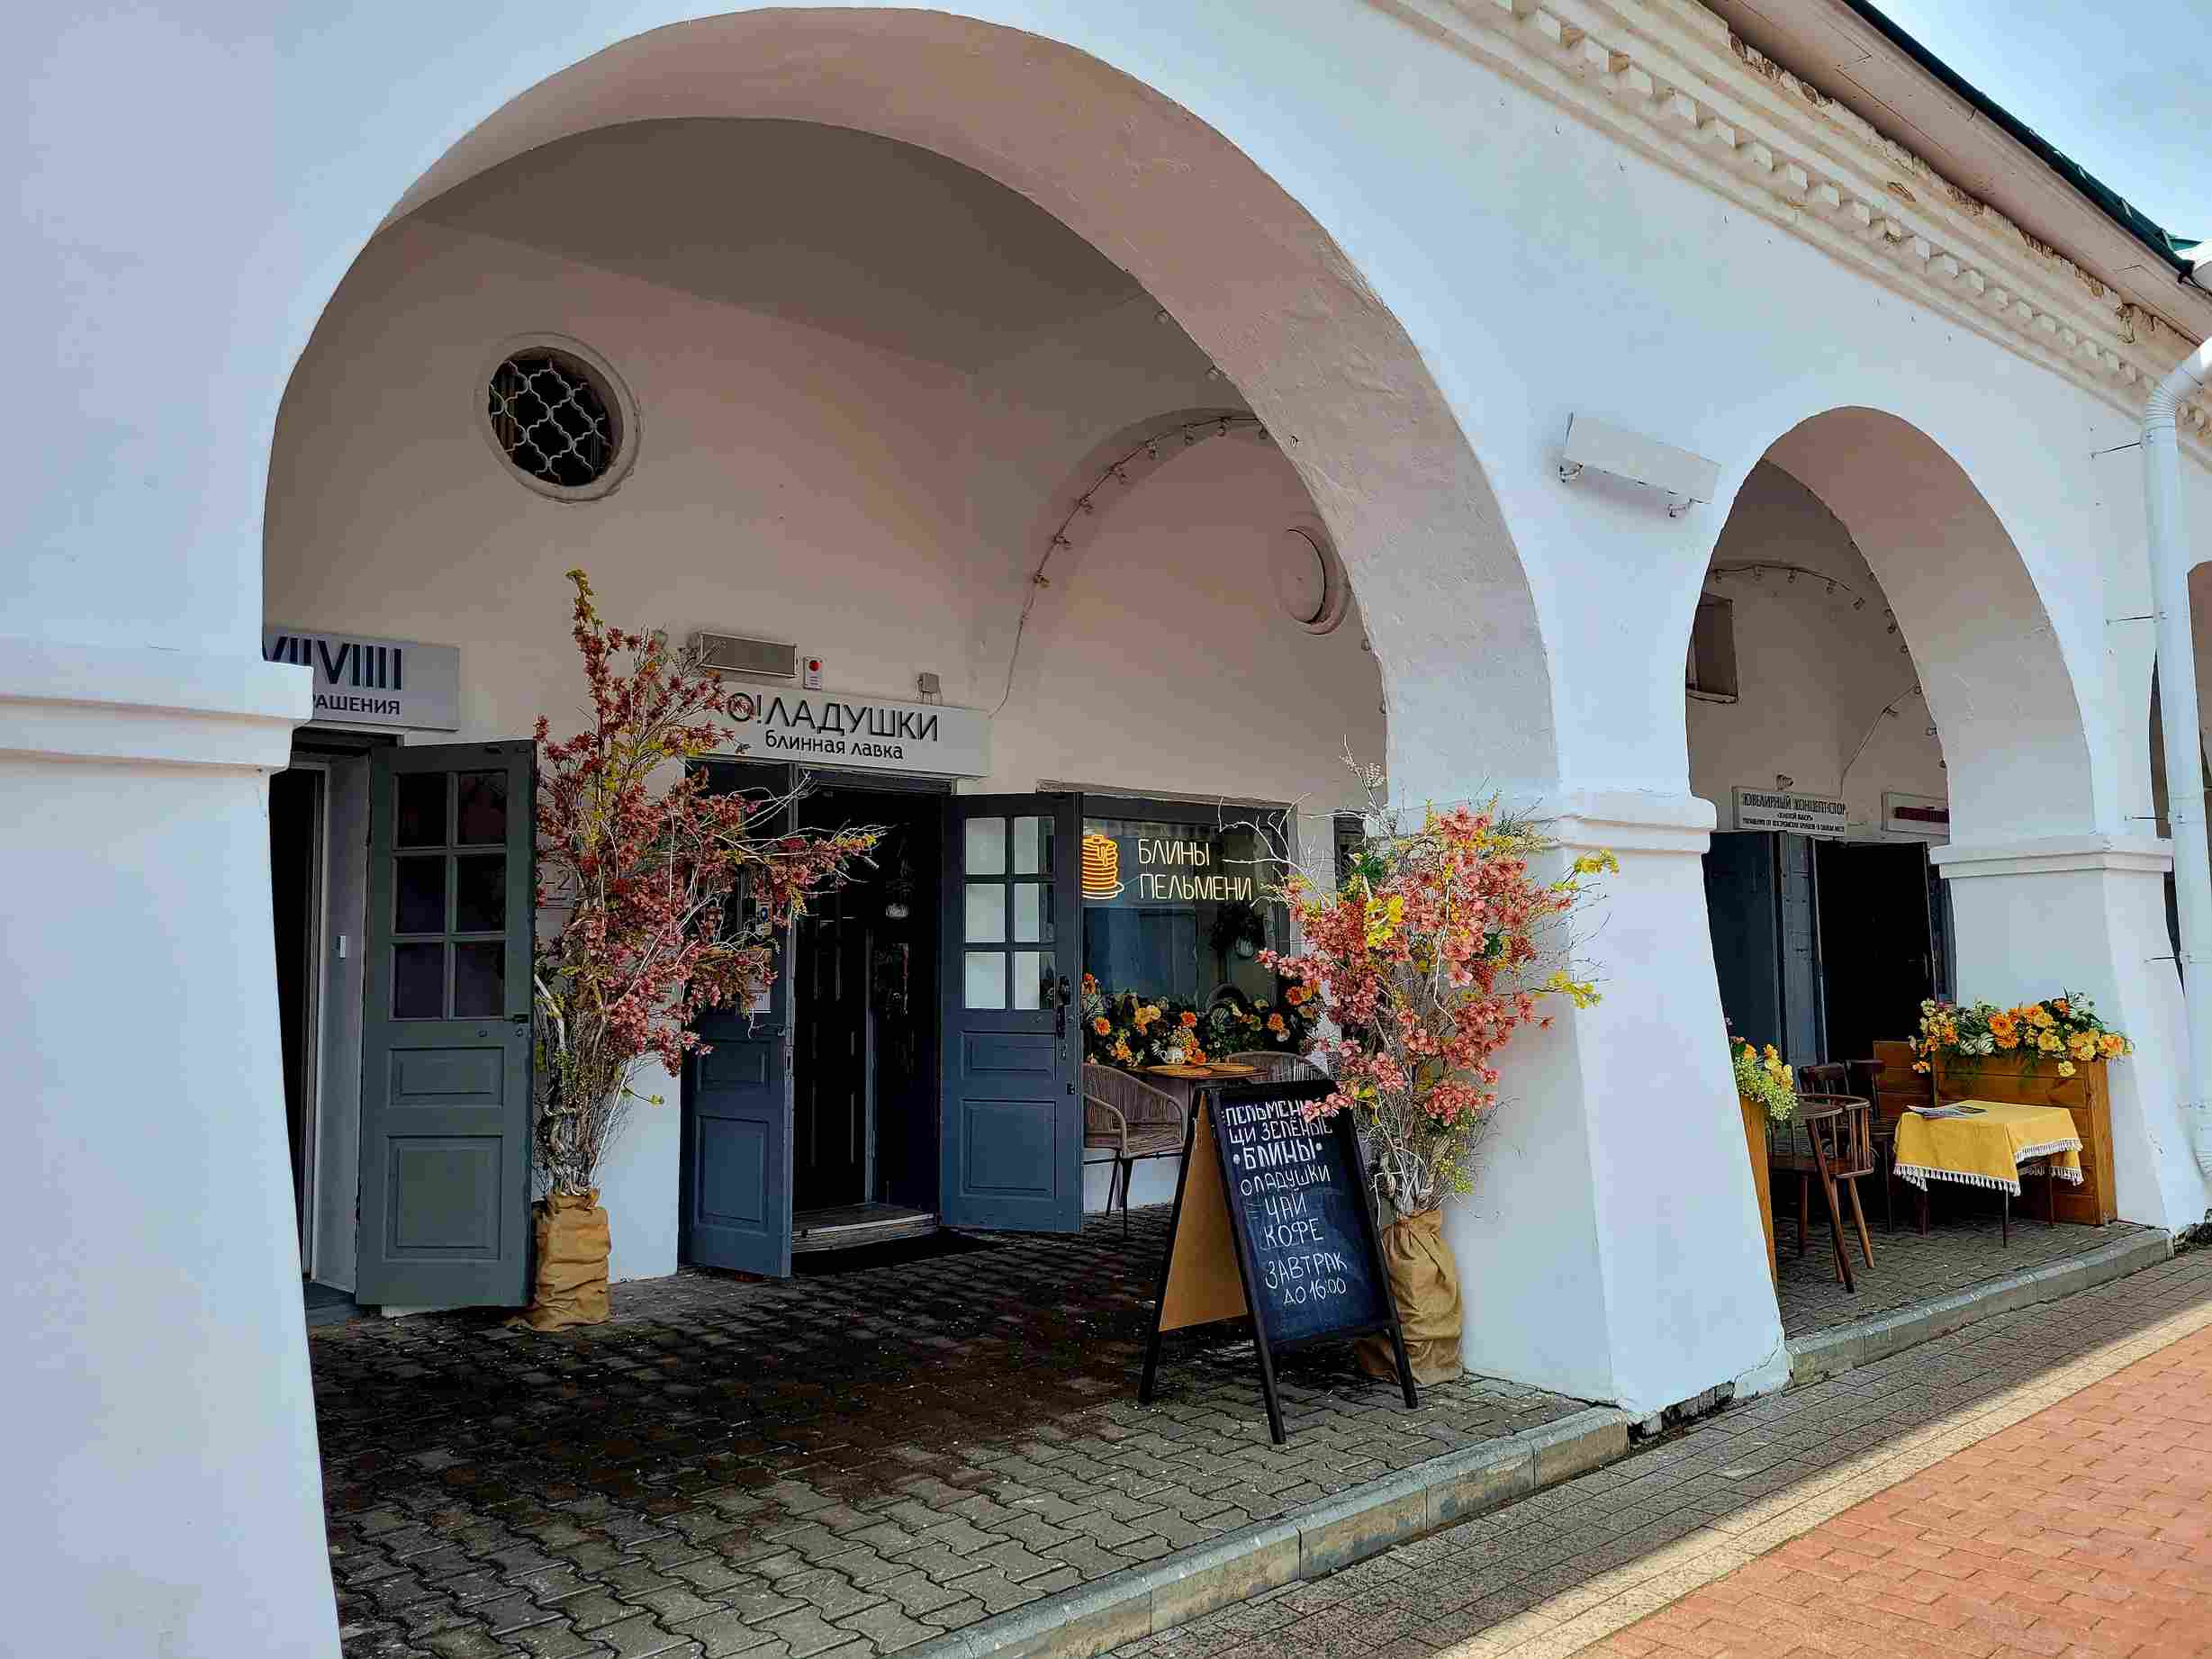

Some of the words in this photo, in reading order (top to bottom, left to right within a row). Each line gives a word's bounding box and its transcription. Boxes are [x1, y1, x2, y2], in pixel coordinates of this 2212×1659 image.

[312, 693, 401, 715] АШЕНИЯ
[728, 692, 938, 742] О!ЛАДУШКИ
[765, 729, 845, 754] блинная
[851, 742, 903, 760] лавка
[1138, 838, 1210, 866] БЛИНЫ
[1140, 873, 1252, 901] ПЕЛЬМЕНИ
[1225, 1098, 1306, 1126] ПЕЛЬМЕН
[1228, 1127, 1256, 1145] ЩИ
[1242, 1138, 1316, 1170] БЛИНЫ
[1240, 1164, 1331, 1195] ОЛАДУШКИ
[1265, 1187, 1308, 1223] ЧАЙ
[1263, 1217, 1323, 1248] КОФЕ
[1265, 1252, 1348, 1288] ЗАВТРАК
[1283, 1286, 1306, 1304] ДО
[1309, 1276, 1347, 1302] 16:00
